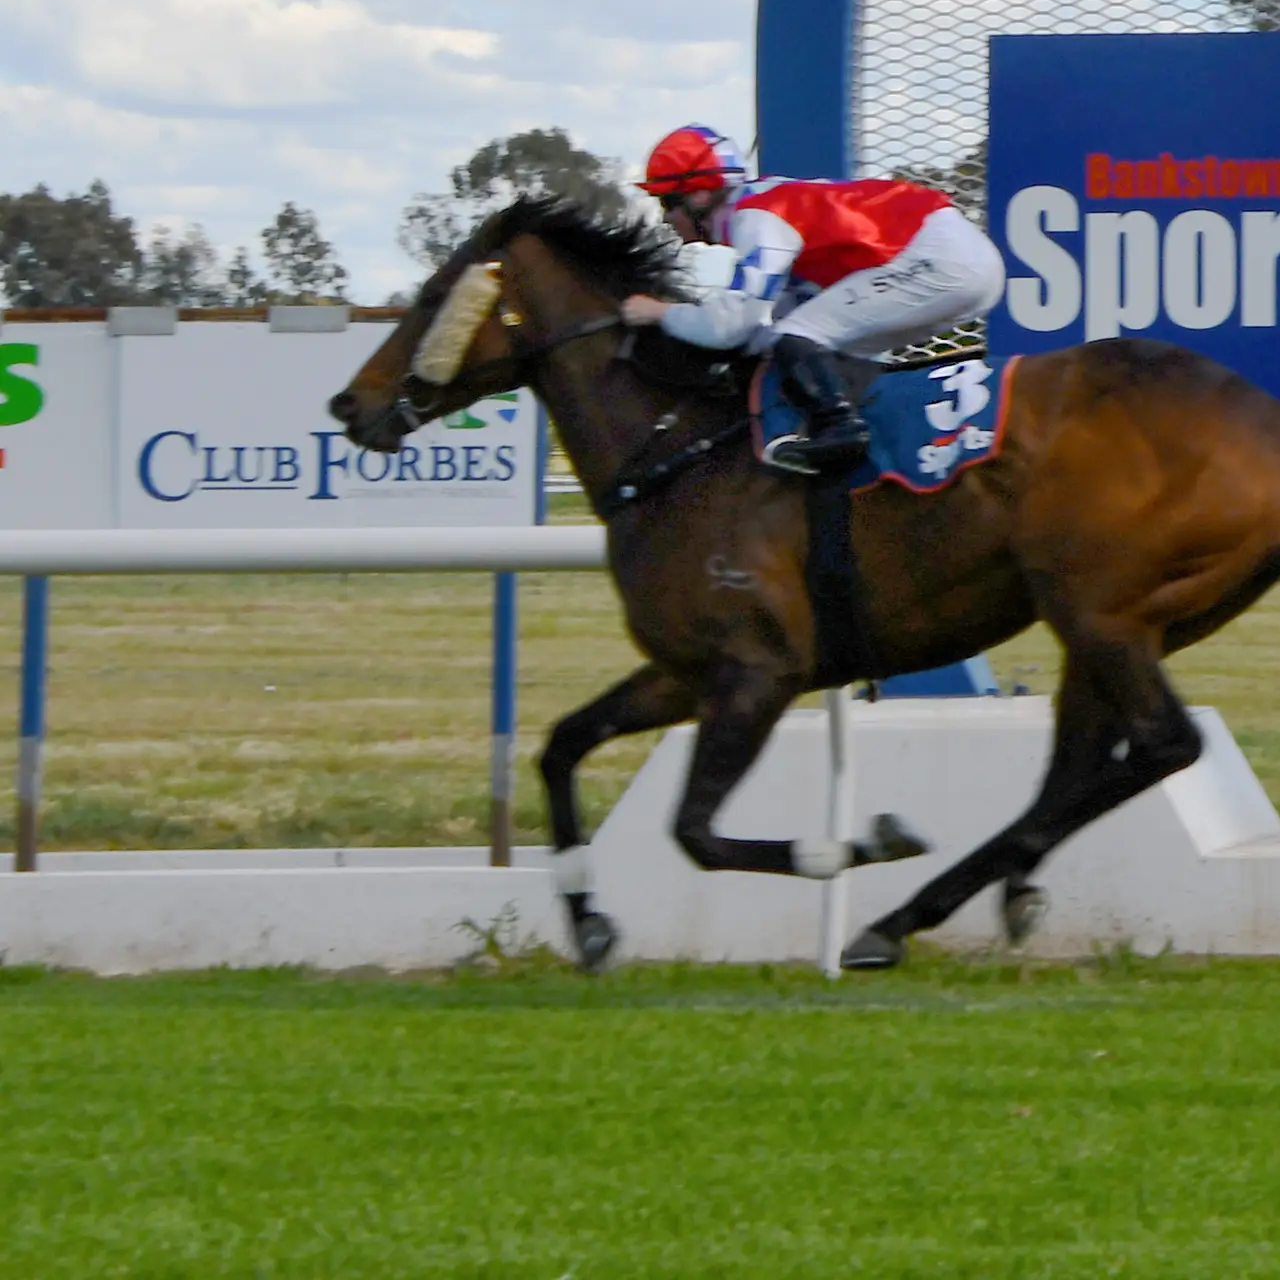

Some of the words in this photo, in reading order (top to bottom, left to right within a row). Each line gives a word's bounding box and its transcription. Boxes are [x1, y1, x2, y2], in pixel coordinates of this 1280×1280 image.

[925, 359, 994, 431] 3
[137, 430, 300, 502] CLUB
[306, 431, 517, 500] FORBES
